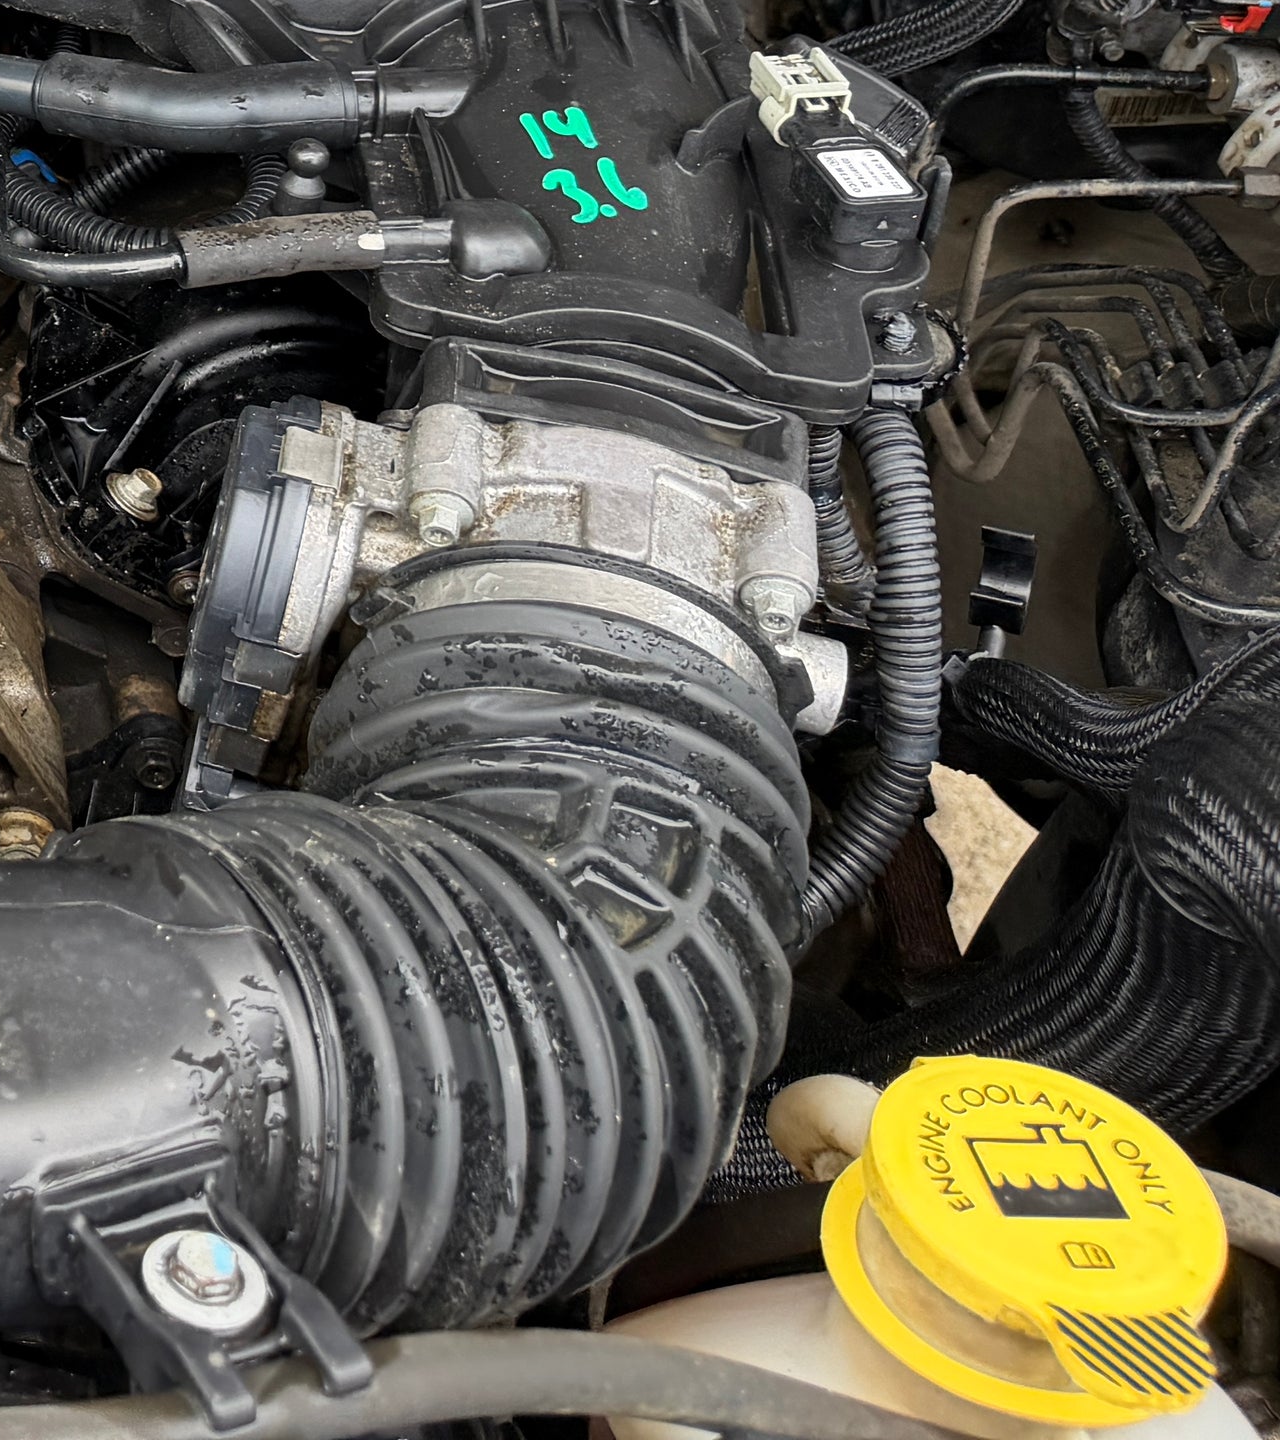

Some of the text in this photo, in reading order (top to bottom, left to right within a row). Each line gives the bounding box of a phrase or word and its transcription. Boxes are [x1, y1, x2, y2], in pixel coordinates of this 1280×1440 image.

[518, 105, 600, 159] 14
[540, 156, 649, 224] 3.6
[919, 1081, 1176, 1218] ENGINE COOLANT ONLY
